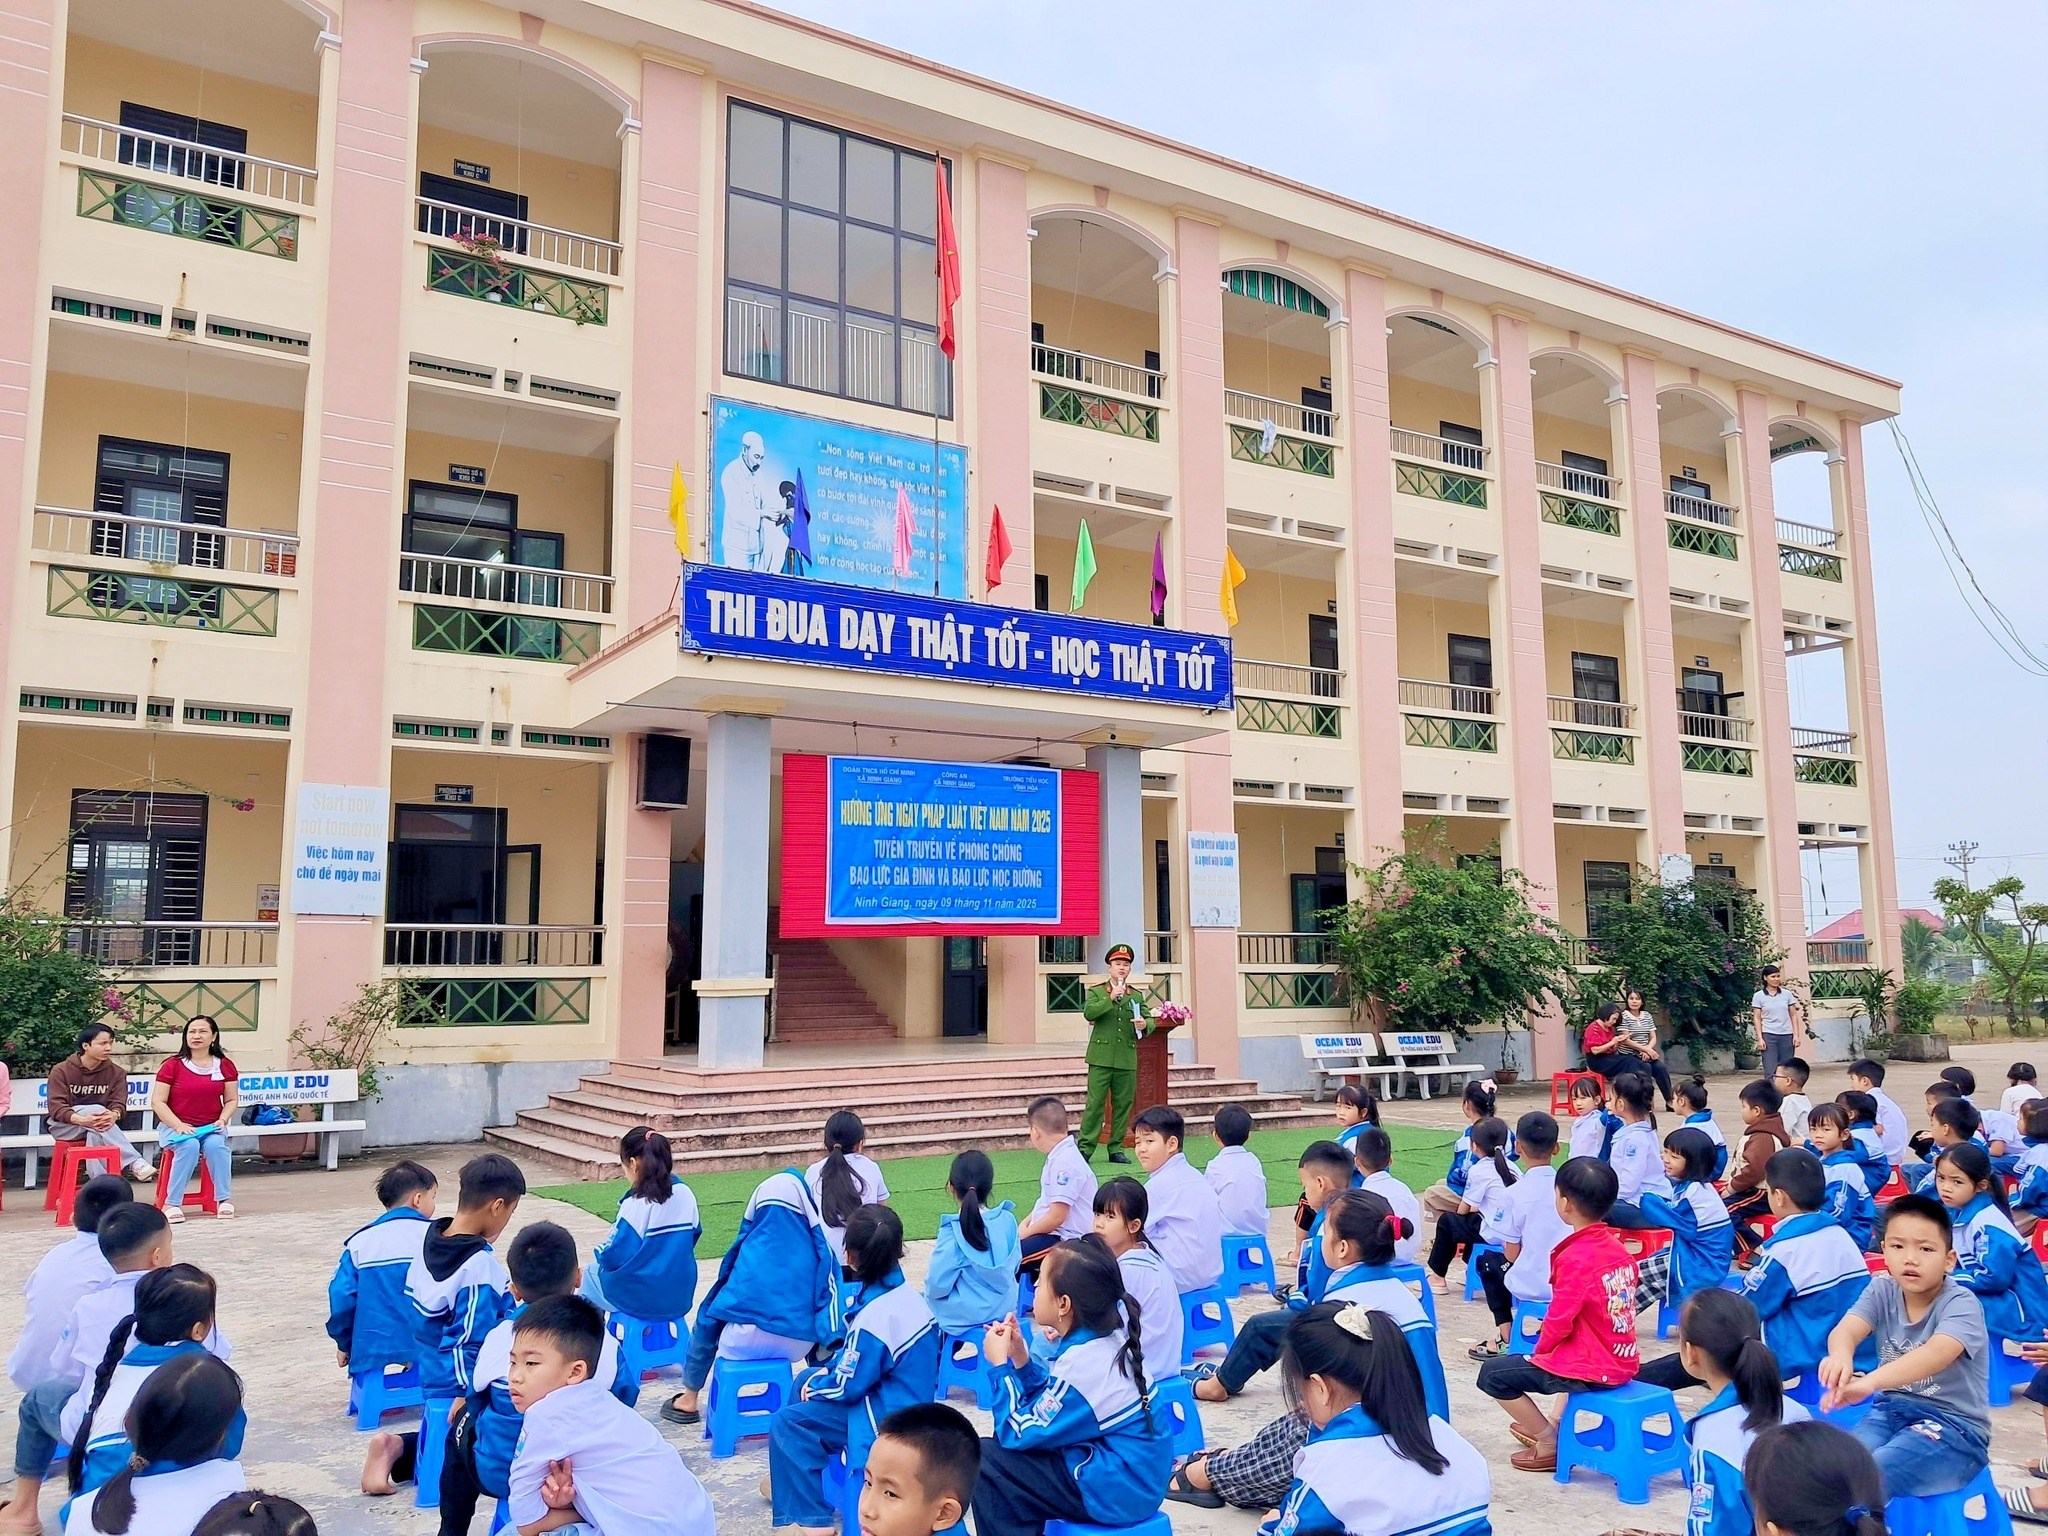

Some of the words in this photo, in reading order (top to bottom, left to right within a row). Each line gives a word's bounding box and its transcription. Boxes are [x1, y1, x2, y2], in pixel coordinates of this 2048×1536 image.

[887, 455, 904, 468] Nam
[849, 470, 862, 484] hay
[817, 531, 830, 546] hay
[707, 589, 756, 639] THI
[766, 597, 829, 648] ĐUA
[839, 607, 896, 661] DẠY
[907, 612, 974, 670] THẬT
[984, 617, 1030, 671] TỐT
[1051, 635, 1100, 685] HỌC
[1109, 639, 1167, 692] THẬT
[1175, 641, 1216, 692] TỐT
[883, 776, 903, 784] GIANG
[941, 771, 958, 779] CÔNG
[313, 793, 344, 812] Start
[347, 797, 376, 814] now
[840, 789, 872, 827] HƯỞNG
[874, 793, 894, 827] ỨNG
[895, 797, 920, 828] NGÀY
[921, 798, 945, 829] PHÁP
[947, 800, 968, 836] LUẬT
[969, 801, 988, 836] VIỆT
[989, 806, 1009, 832] NAM
[1010, 803, 1030, 833] NĂM
[1031, 809, 1052, 834] 2025
[306, 845, 328, 862] Việc
[331, 847, 354, 861] hôm
[356, 849, 376, 863] nay
[873, 835, 904, 859] TUYÊN
[906, 834, 943, 860] TRUYỀN
[945, 835, 957, 861] VỀ
[959, 838, 990, 862] PHÒNG
[991, 837, 1022, 863] CHỐNG
[296, 866, 316, 880] chớ
[318, 864, 332, 880] để
[334, 867, 360, 883] ngày
[362, 868, 382, 882] mai
[849, 866, 870, 890] BẠO
[872, 865, 891, 890] LỰC
[893, 866, 910, 886] GIA
[912, 862, 936, 886] ĐÌNH
[937, 863, 950, 887] VÀ
[951, 867, 971, 891] BẠO
[973, 866, 990, 891] LỰC
[992, 868, 1011, 891] HỌC
[1012, 864, 1042, 888] ĐƯỜNG
[854, 896, 878, 908] Ninh
[881, 896, 913, 911] Giang,
[915, 896, 939, 911] ngày
[941, 897, 952, 908] 09
[954, 897, 981, 911] tháng
[983, 898, 992, 909] 11
[995, 899, 1014, 909] năm
[1016, 899, 1037, 909] 2025
[1315, 1037, 1344, 1047] OCEAN
[1345, 1037, 1362, 1046] EDU
[1397, 1035, 1424, 1044] OCEAN
[1425, 1035, 1441, 1043] EDU
[237, 1077, 288, 1091] CEAN
[294, 1075, 329, 1088] EDU
[239, 1091, 264, 1101] THỐNG
[266, 1092, 280, 1101] ANH
[283, 1090, 298, 1100] NGỮ
[300, 1090, 318, 1100] QUỐC
[320, 1090, 329, 1099] TẾ
